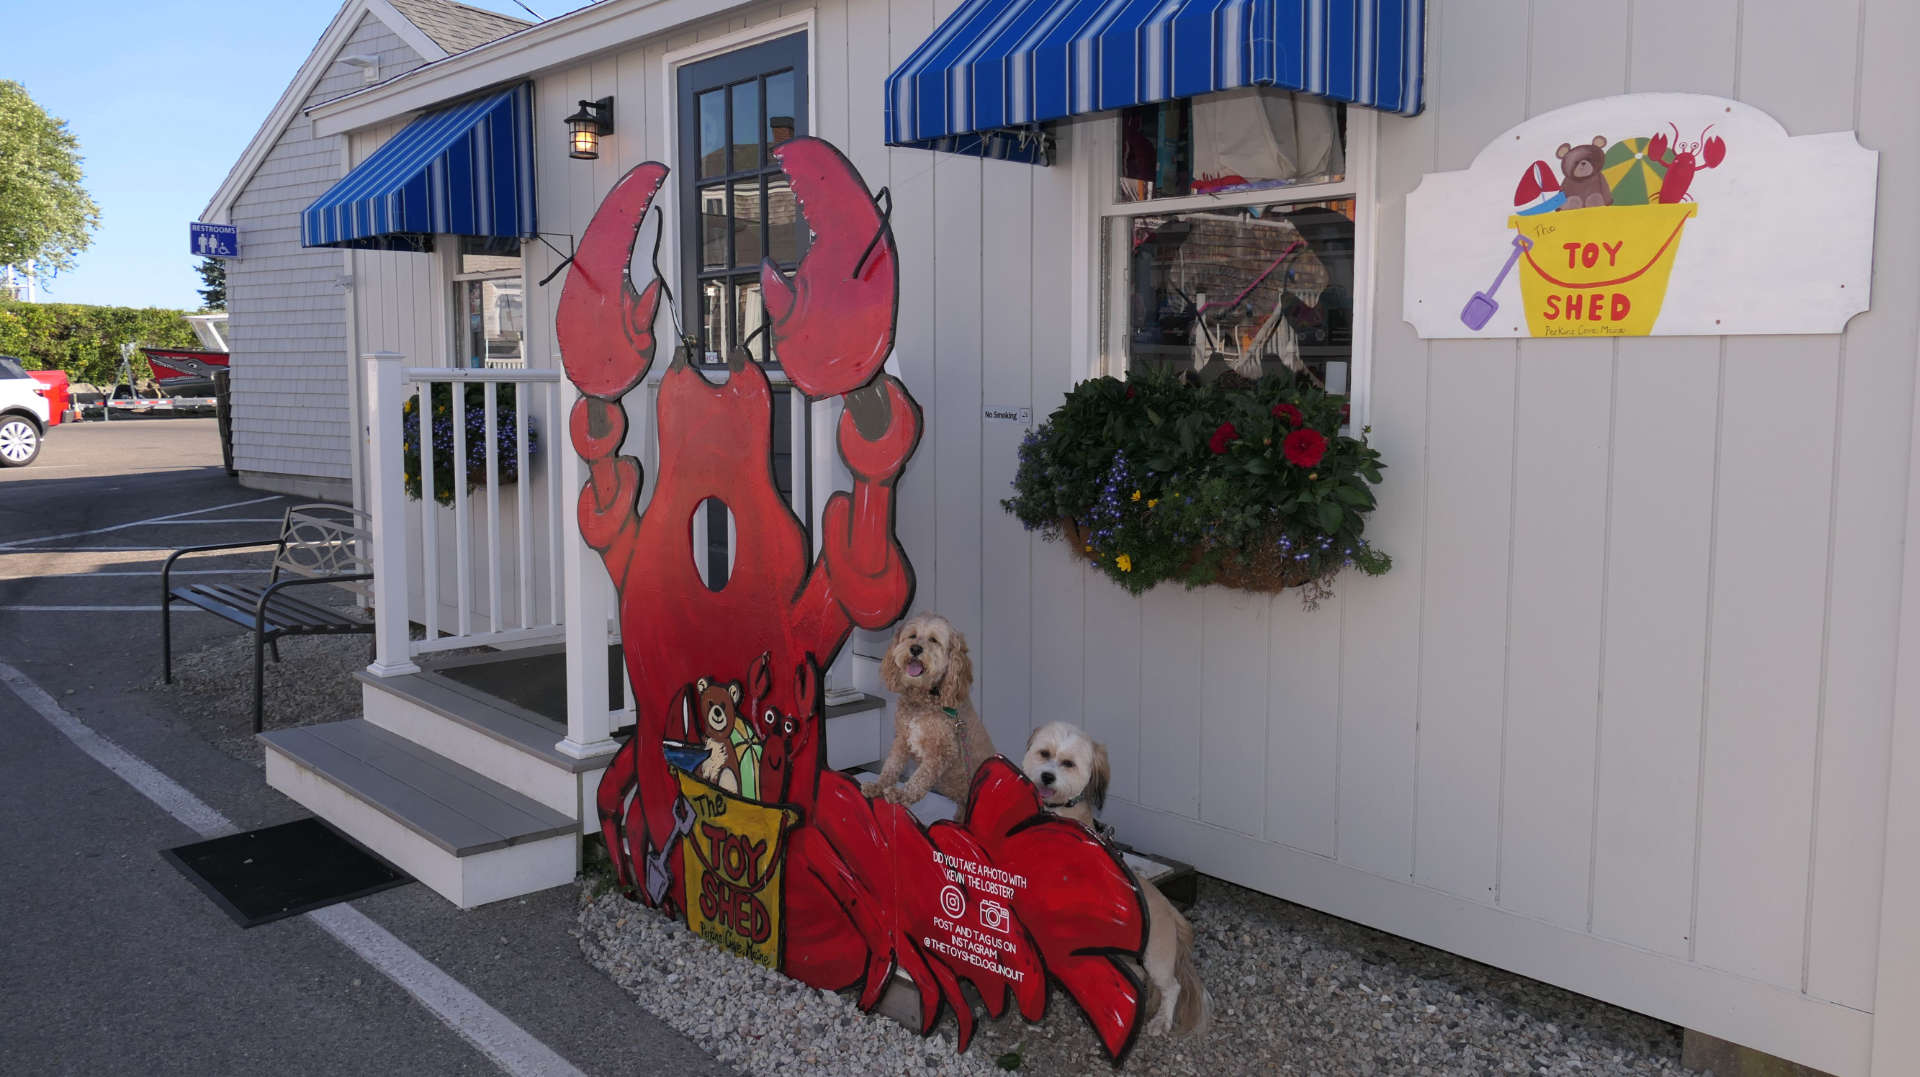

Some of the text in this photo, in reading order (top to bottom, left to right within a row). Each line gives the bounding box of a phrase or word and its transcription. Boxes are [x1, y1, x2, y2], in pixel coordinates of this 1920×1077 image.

[191, 225, 236, 234] RESTROOMS
[1563, 241, 1623, 269] TOY
[1543, 293, 1631, 321] SHED
[993, 411, 1017, 421] Smoking
[694, 794, 727, 818] The
[701, 820, 768, 887] TOY
[932, 851, 1027, 888] DID YOU TAKE A PHOTO WITH
[967, 875, 980, 890] THE
[981, 880, 1014, 900] LOBSTER?
[699, 871, 772, 943] SHED
[933, 916, 1017, 954] POST AND TAG US ON
[951, 934, 998, 960] INSTAGRAM
